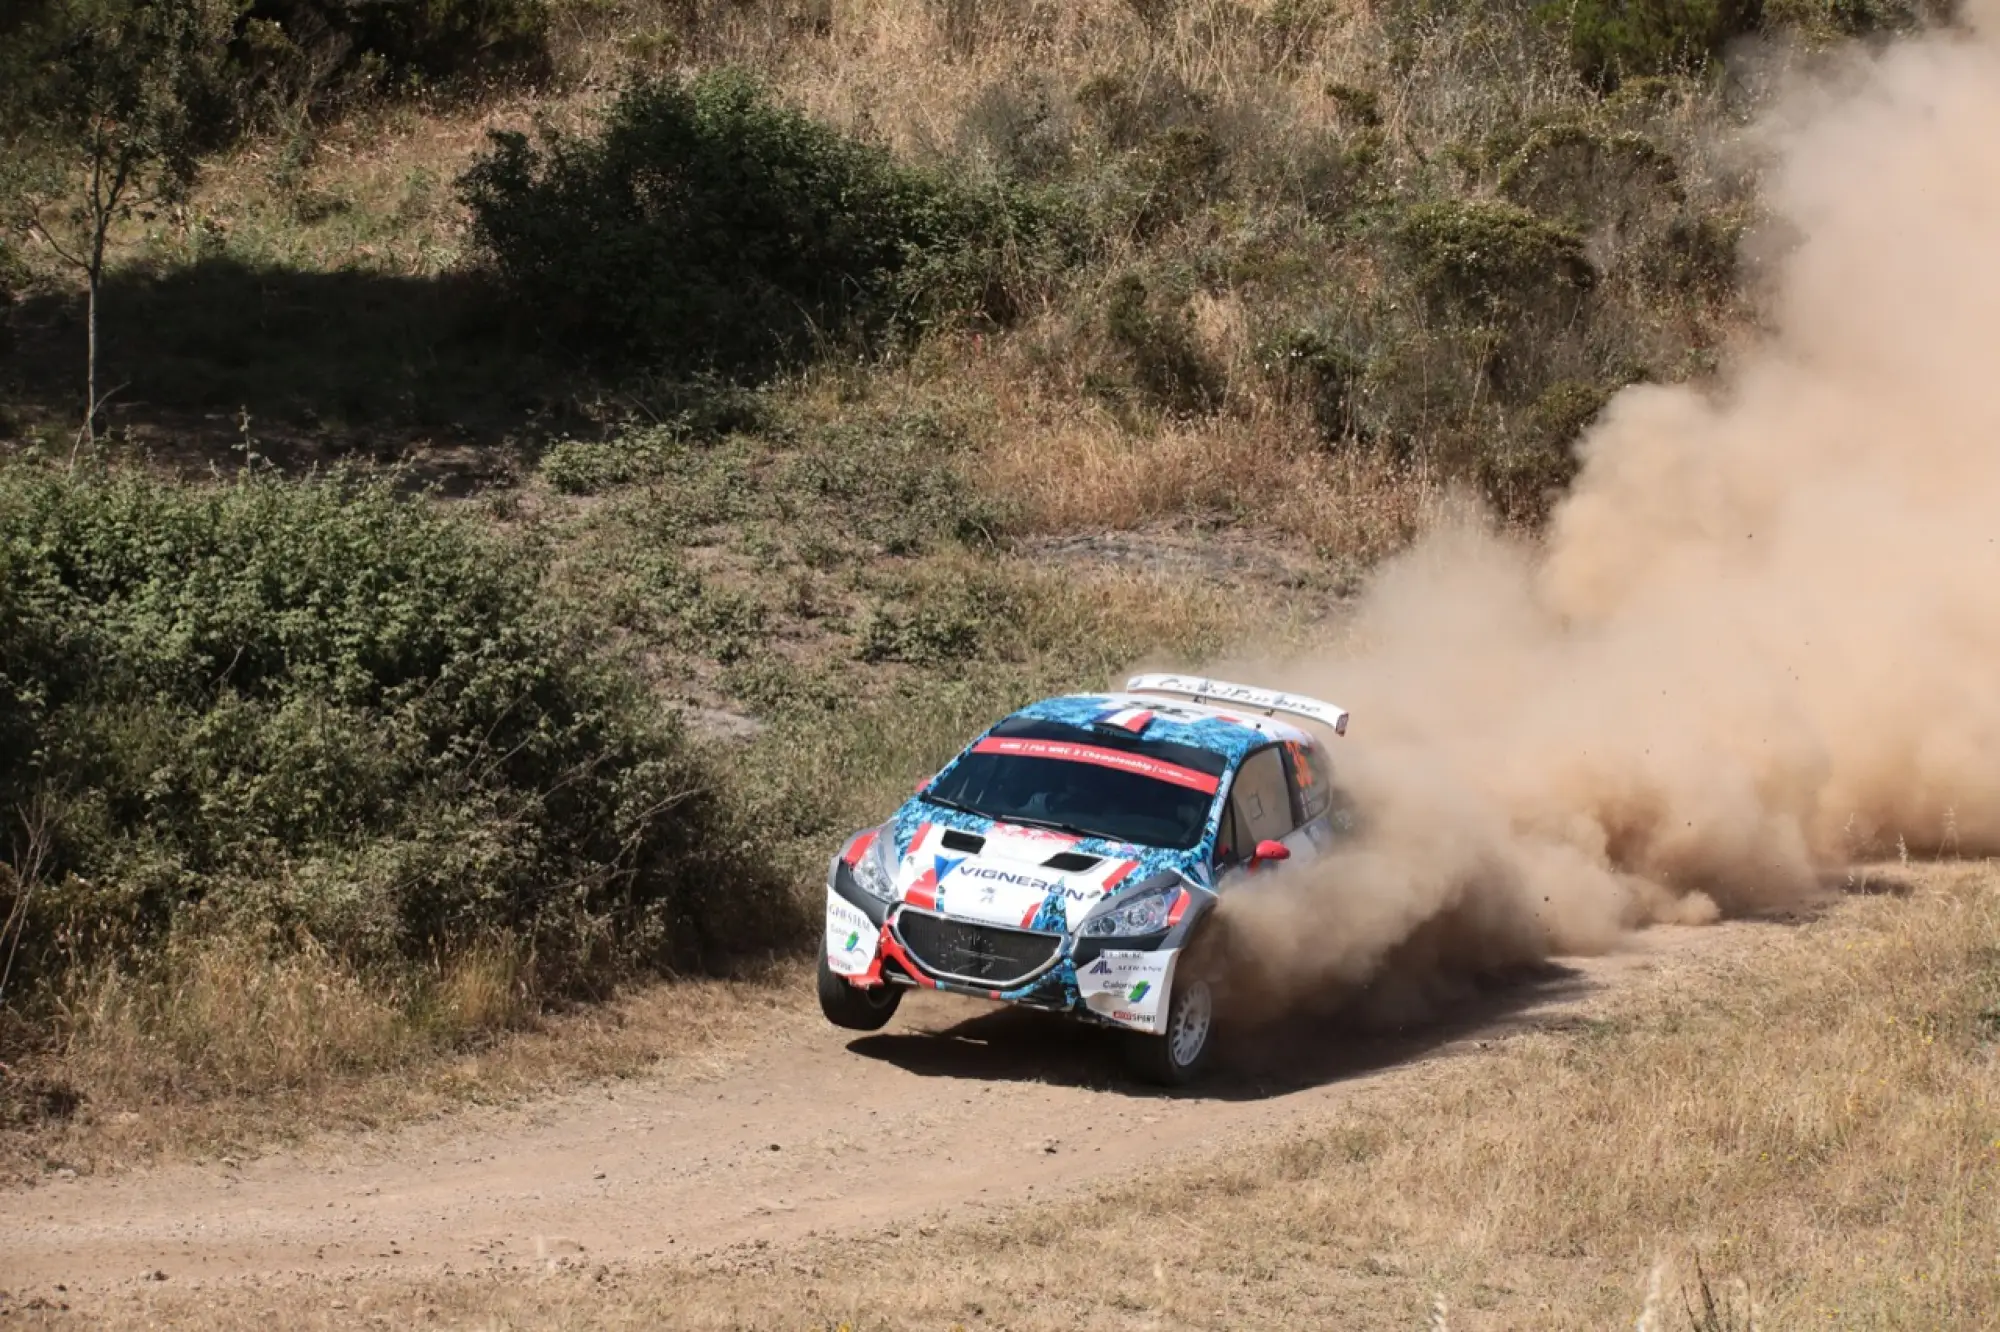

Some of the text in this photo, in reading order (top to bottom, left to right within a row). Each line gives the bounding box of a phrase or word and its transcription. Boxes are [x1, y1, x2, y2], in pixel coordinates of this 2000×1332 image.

[1048, 745, 1071, 755] WRC
[1081, 750, 1154, 772] Championship
[960, 865, 1084, 901] VIGNERON
